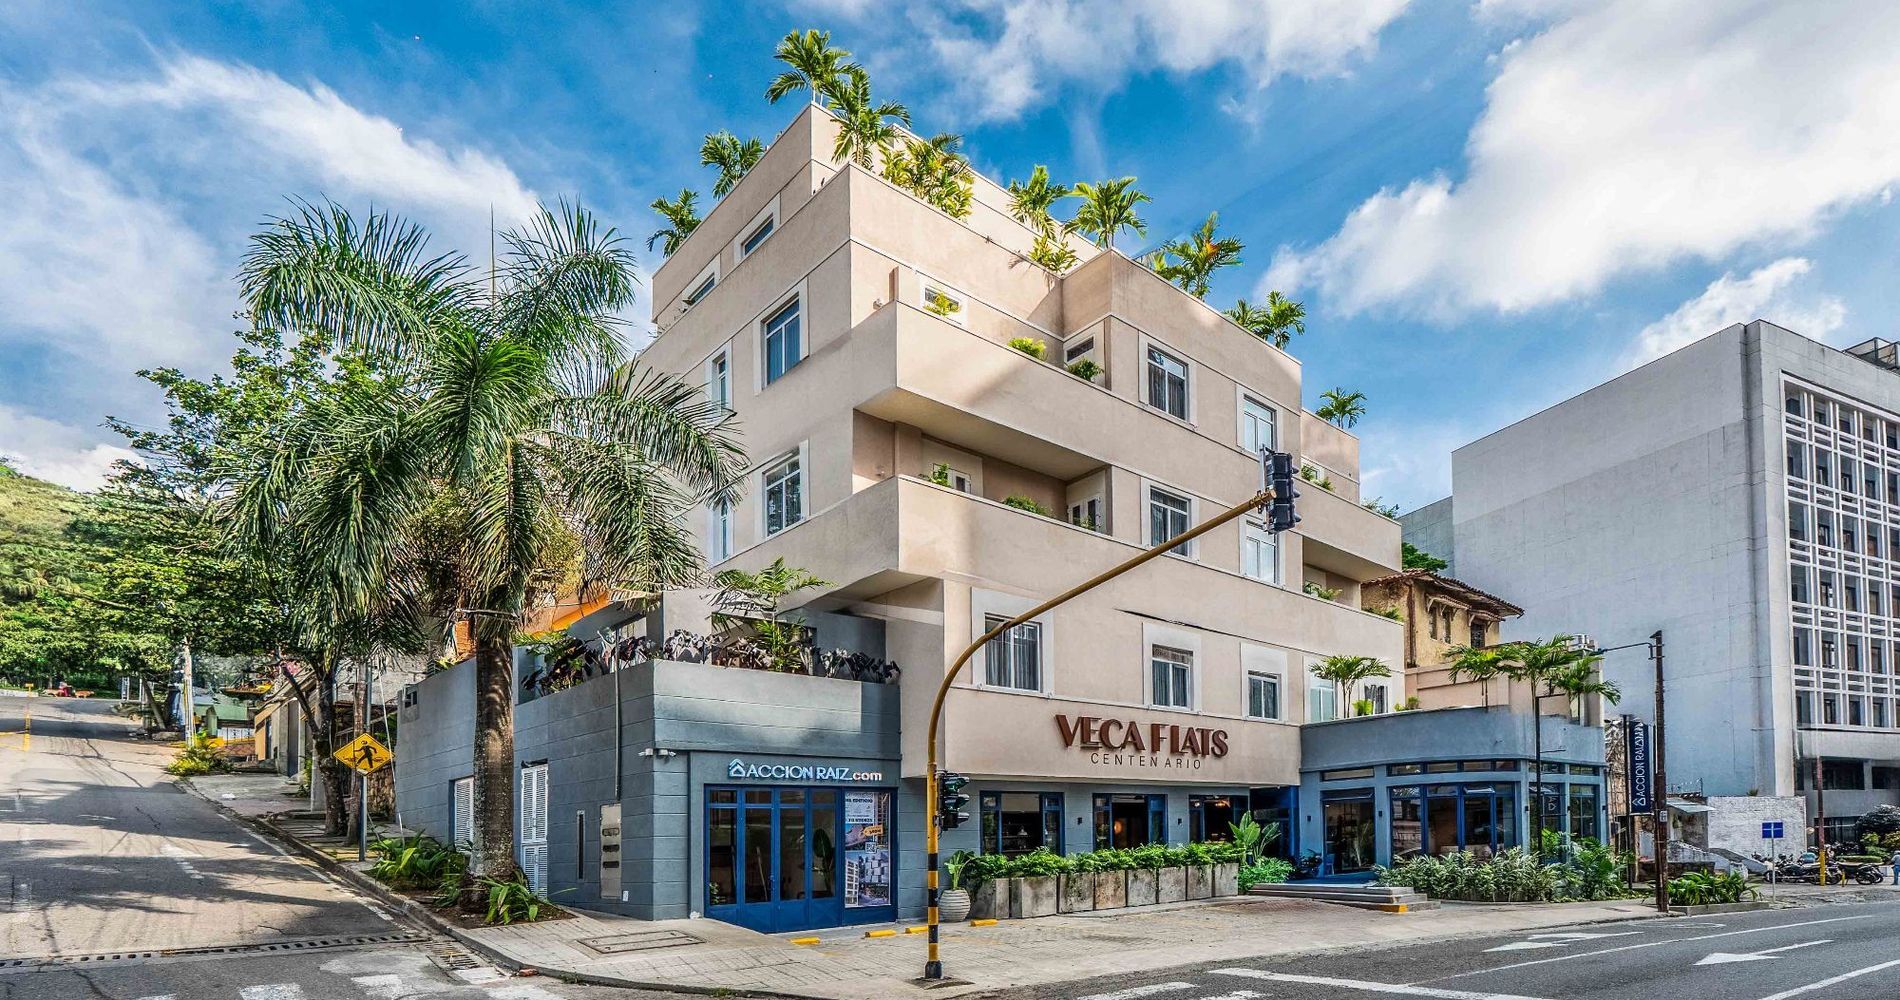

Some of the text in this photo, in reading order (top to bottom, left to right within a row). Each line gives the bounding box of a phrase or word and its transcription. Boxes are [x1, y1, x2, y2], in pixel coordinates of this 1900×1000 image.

[1055, 714, 1229, 758] VECA FLATS
[746, 763, 882, 781] ACCION RAIZ.com
[1090, 752, 1201, 770] CENTENARIO
[1635, 763, 1646, 797] ACCION
